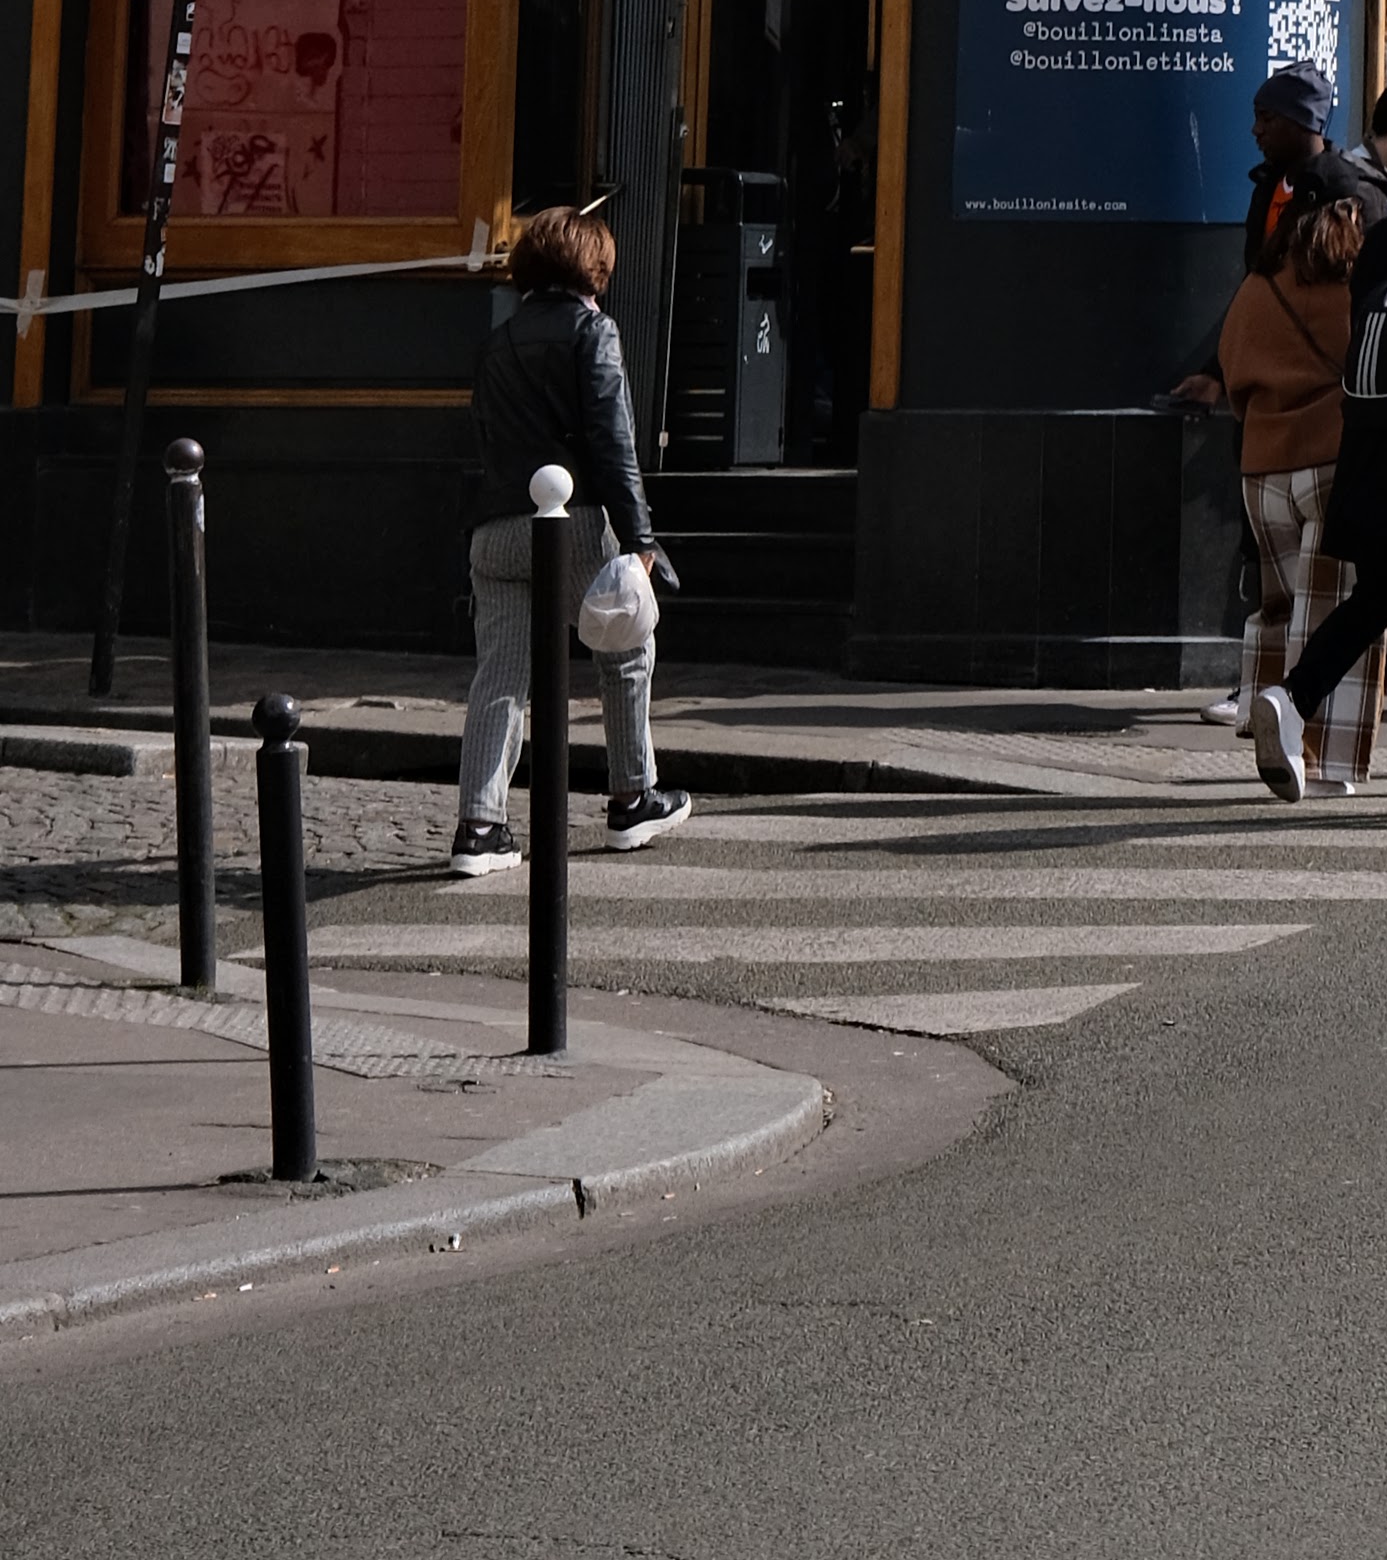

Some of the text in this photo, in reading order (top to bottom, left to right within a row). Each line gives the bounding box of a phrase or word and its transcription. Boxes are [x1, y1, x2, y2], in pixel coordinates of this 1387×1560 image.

[1022, 21, 1223, 45] @bouillonlinsta
[1009, 50, 1235, 73] @bouillonletiktok
[965, 198, 1128, 212] www.bouillonlesite.com
